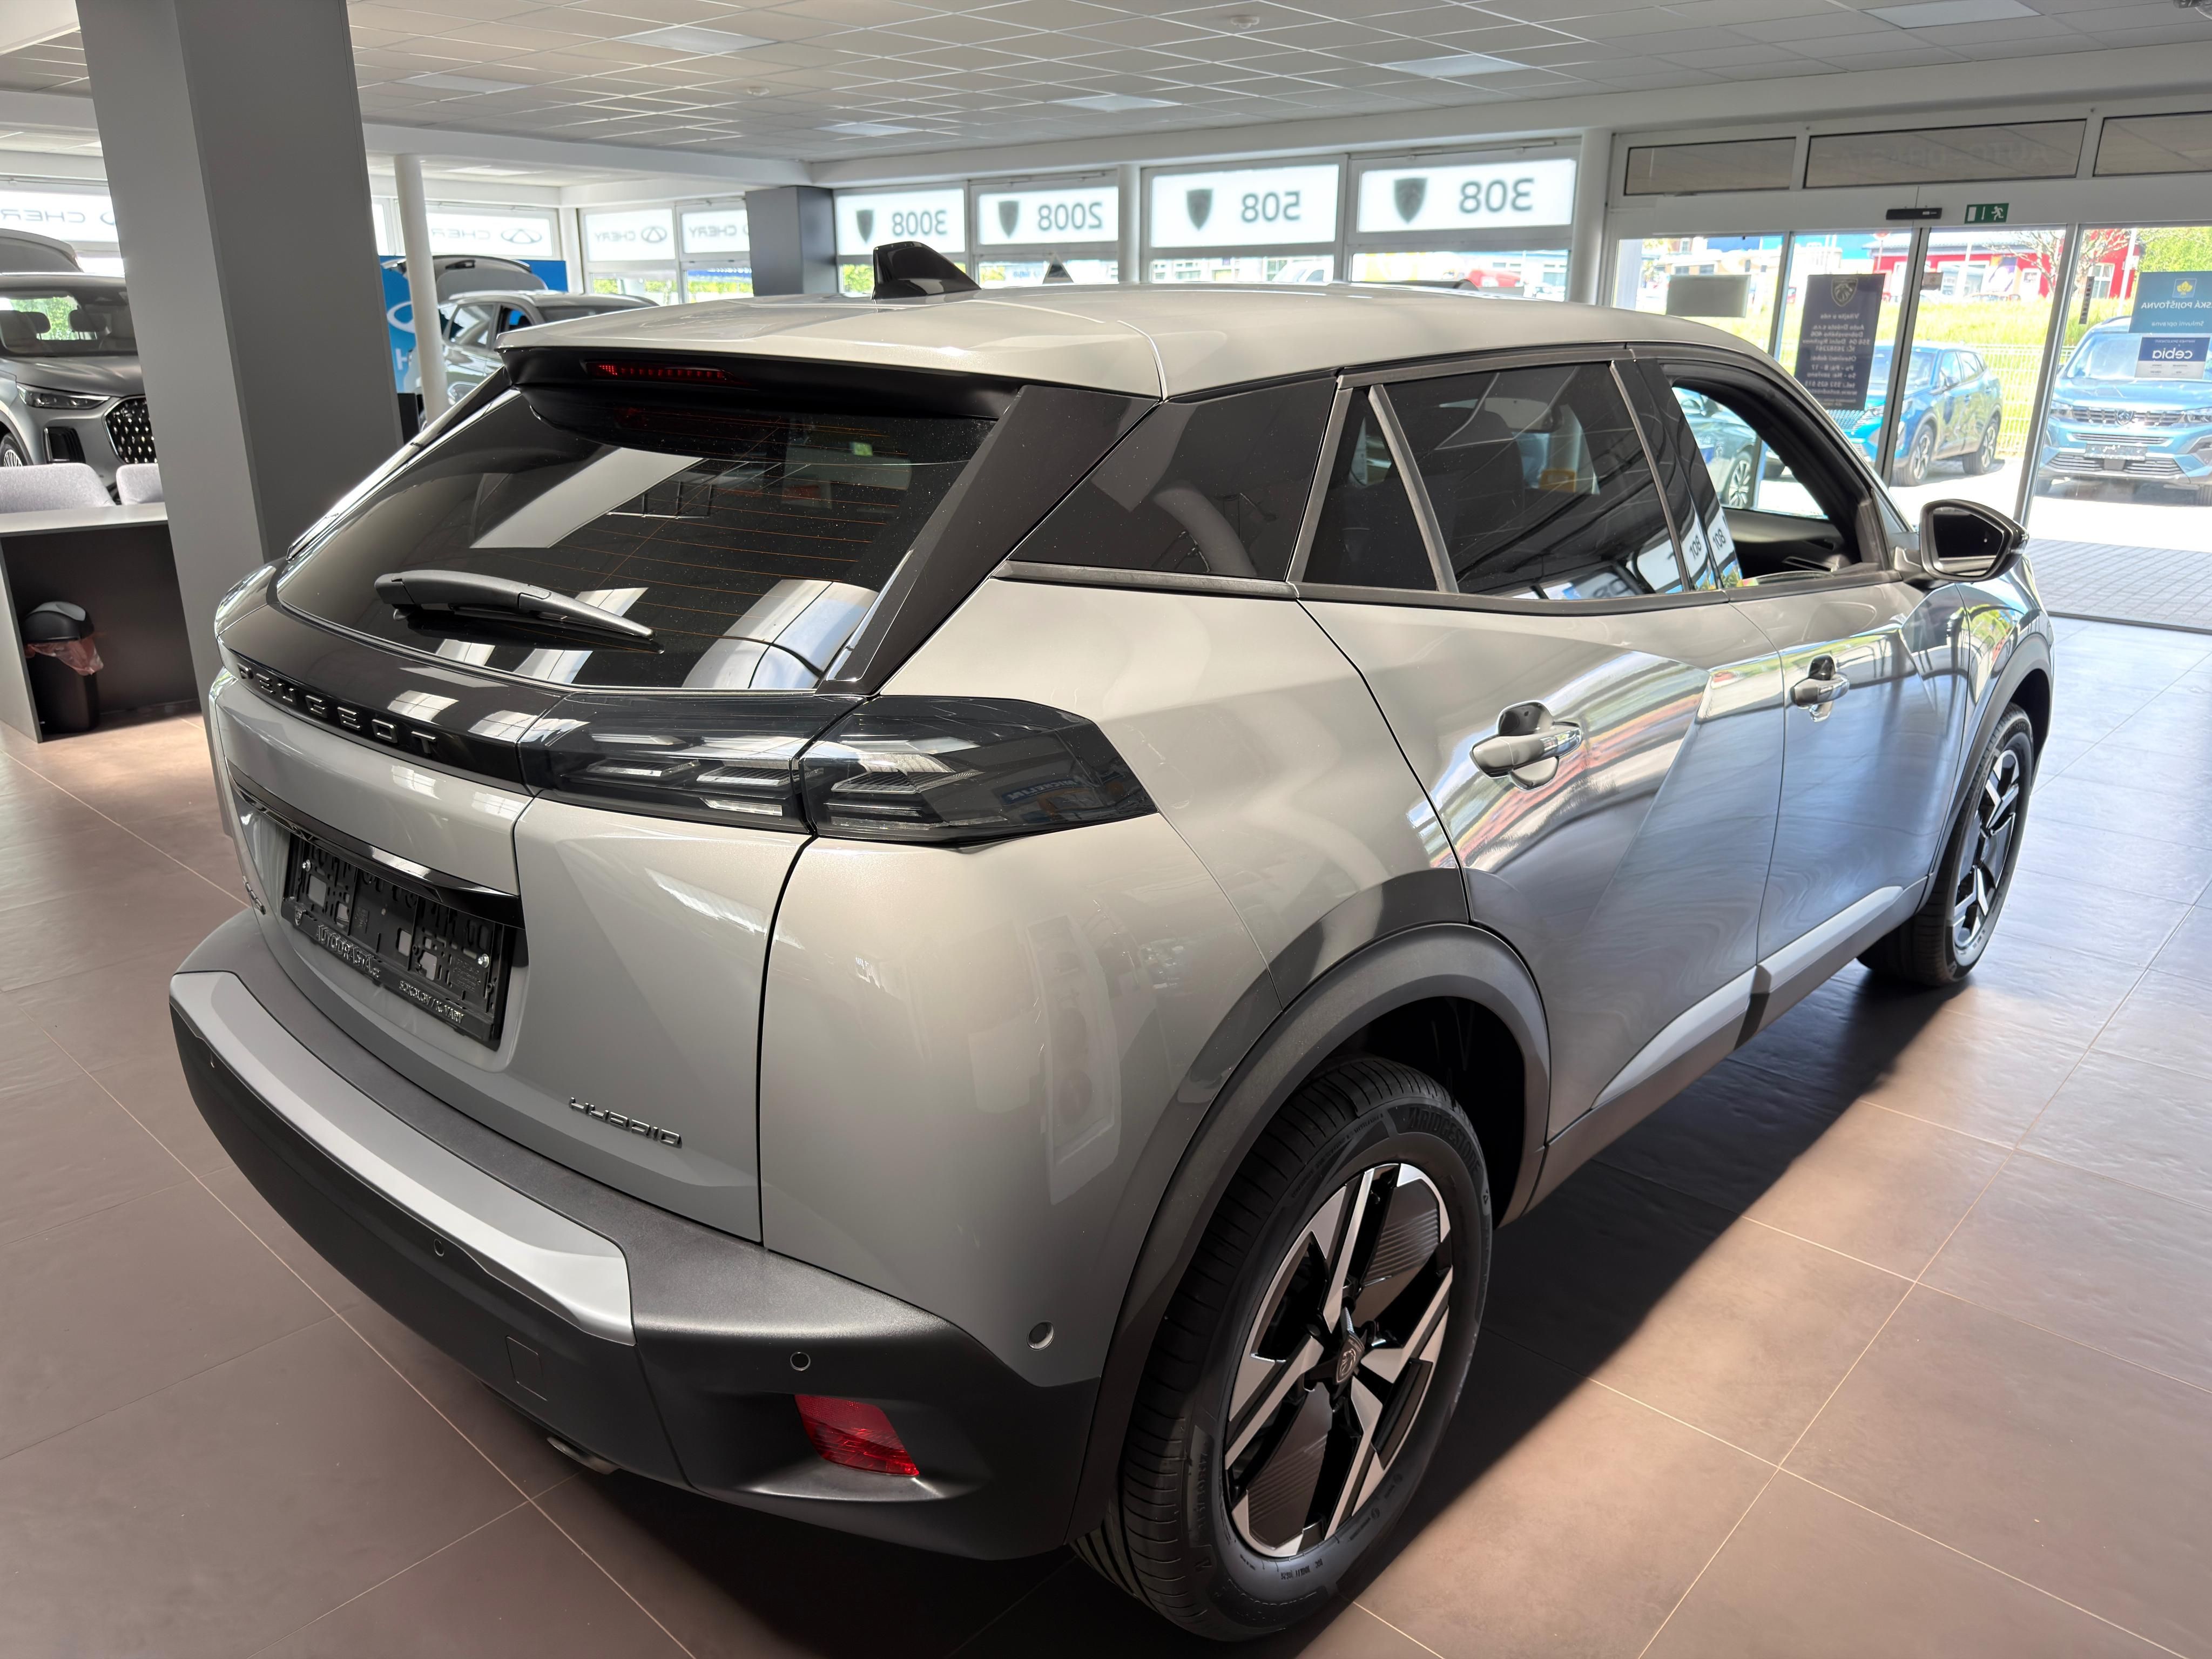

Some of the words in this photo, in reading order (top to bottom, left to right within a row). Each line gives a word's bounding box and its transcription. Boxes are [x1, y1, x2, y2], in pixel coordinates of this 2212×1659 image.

[1688, 535, 1702, 561] 108
[1712, 529, 1727, 551] 108
[237, 662, 437, 754] PEUGEOT
[399, 980, 432, 1006] SOKOLOV
[443, 1004, 465, 1024] VARY
